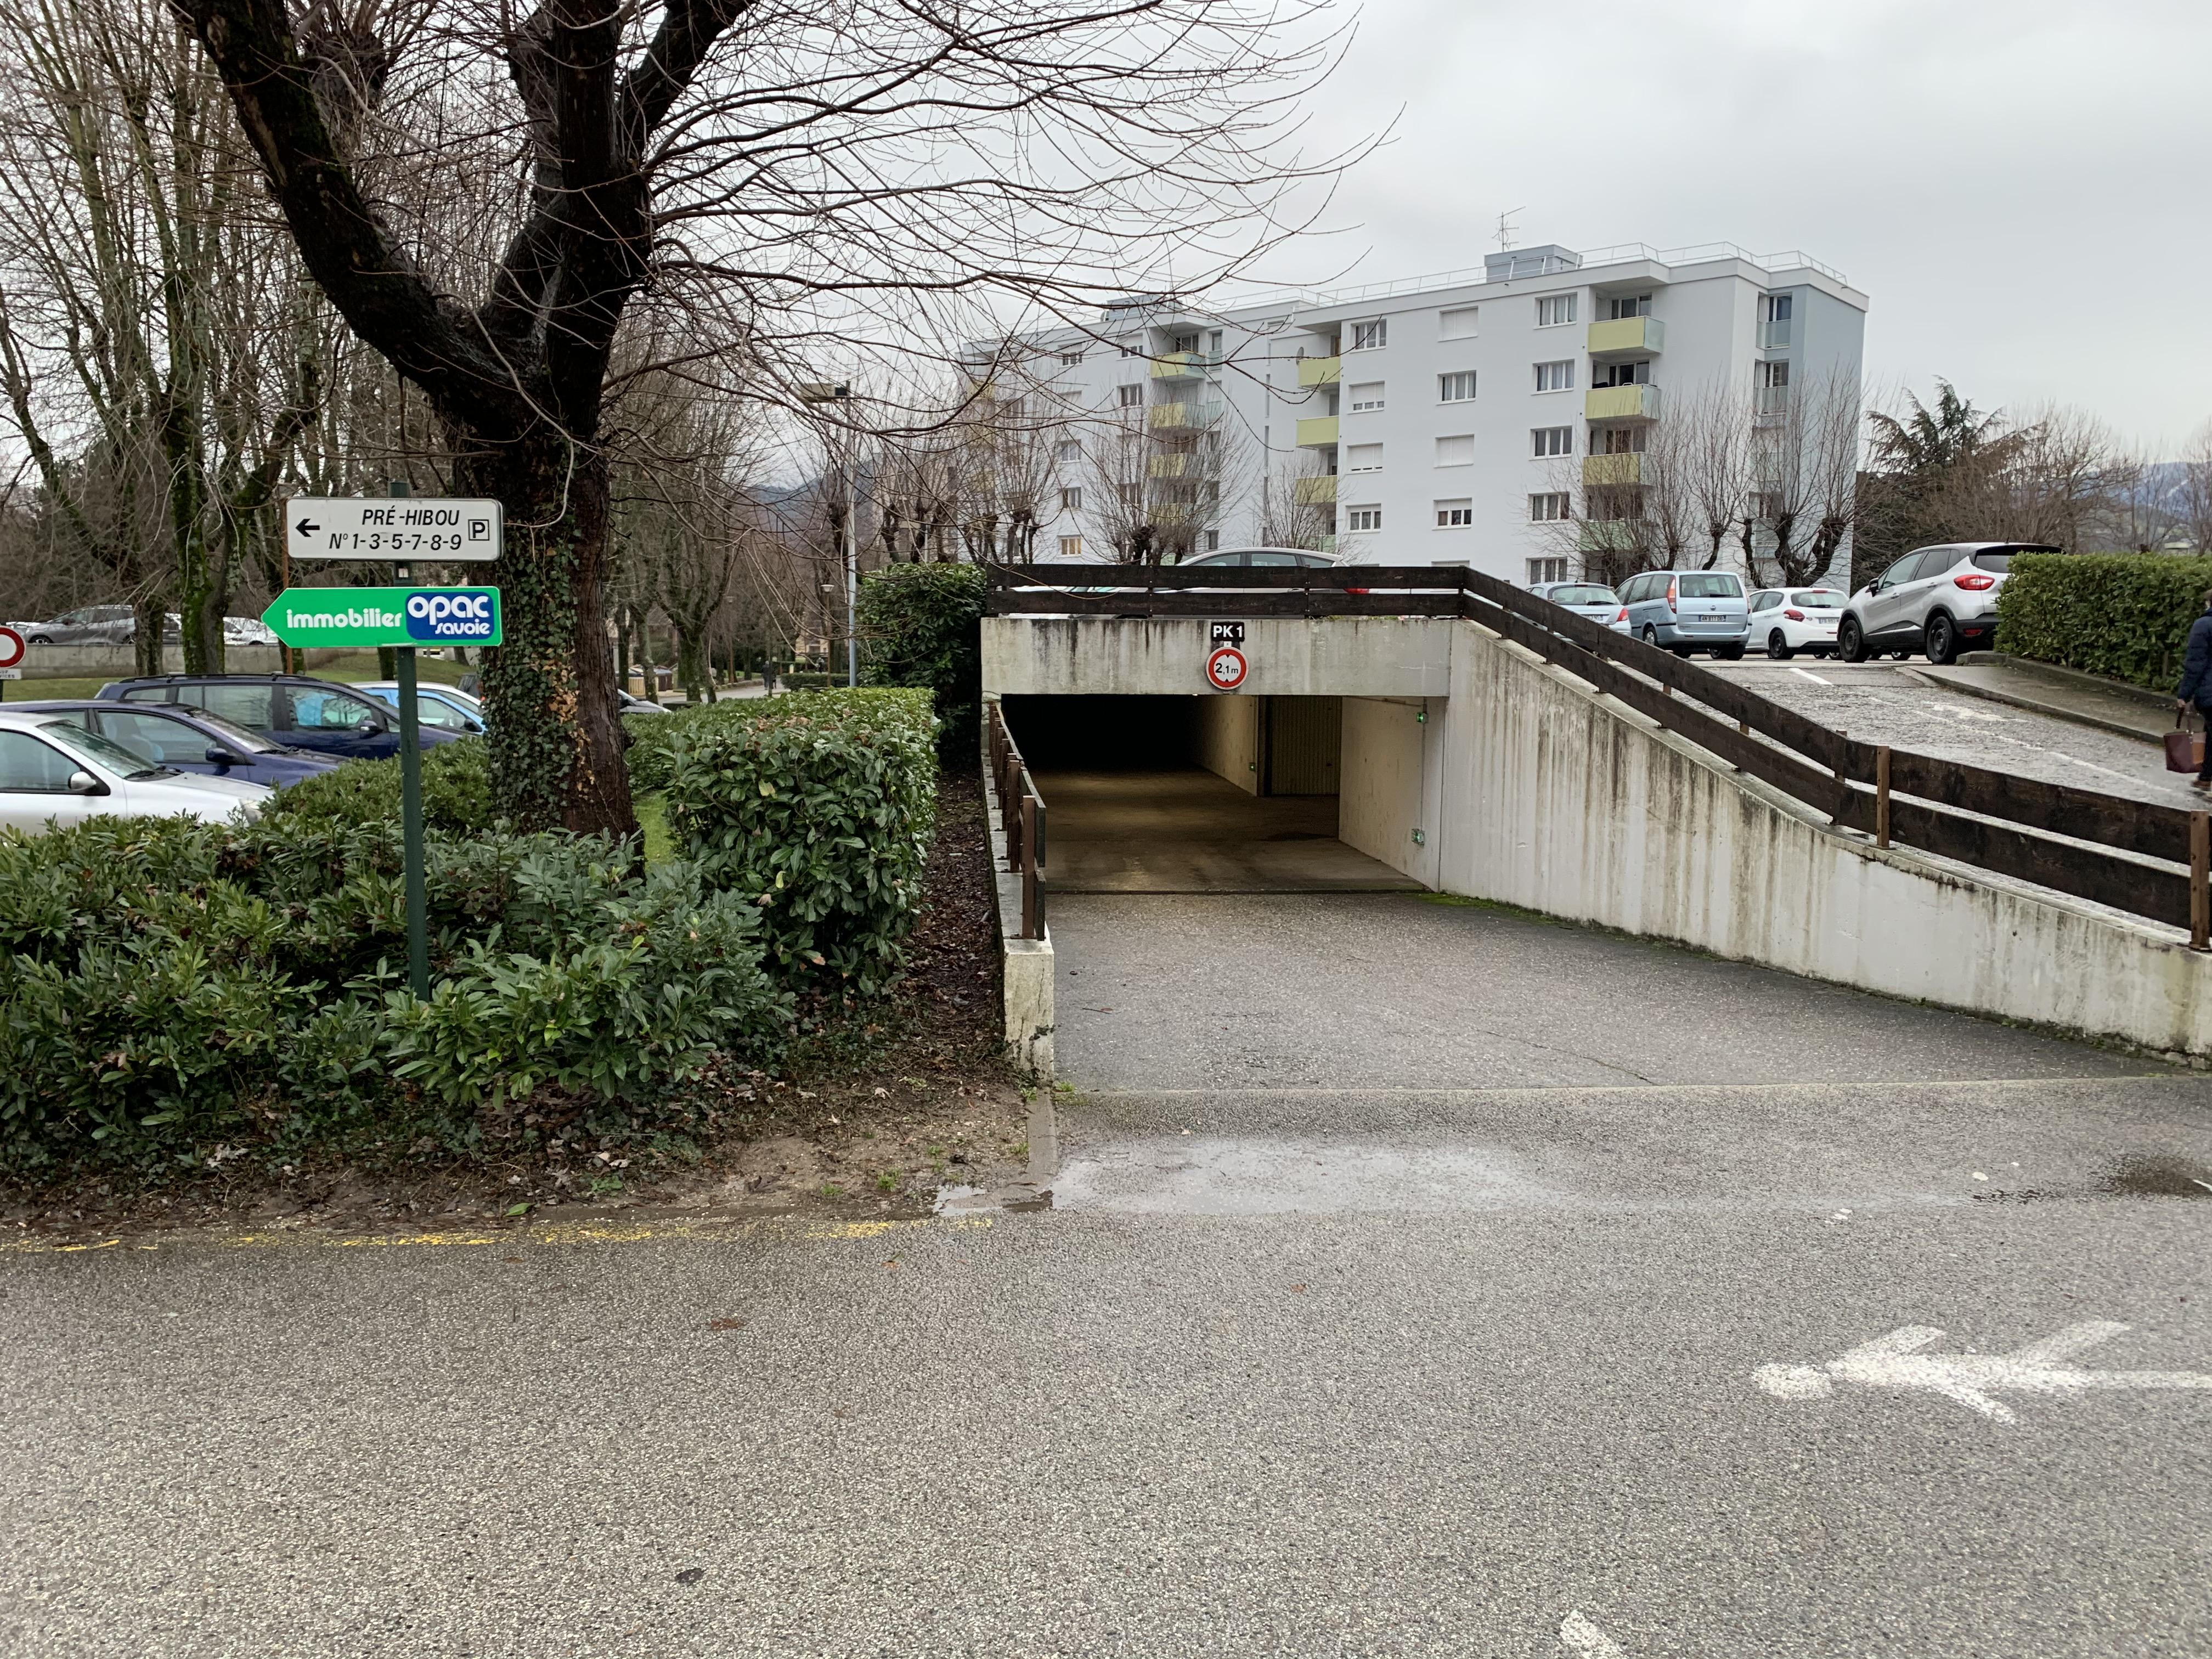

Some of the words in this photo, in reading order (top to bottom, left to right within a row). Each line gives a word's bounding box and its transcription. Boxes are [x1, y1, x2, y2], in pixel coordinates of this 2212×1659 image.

[362, 505, 460, 526] PRÉ-HIBOU
[472, 522, 486, 539] P
[286, 608, 402, 628] immobilier
[407, 596, 489, 625] opac
[435, 618, 490, 635] savoie
[1213, 625, 1234, 637] PK
[1237, 625, 1243, 637] 1
